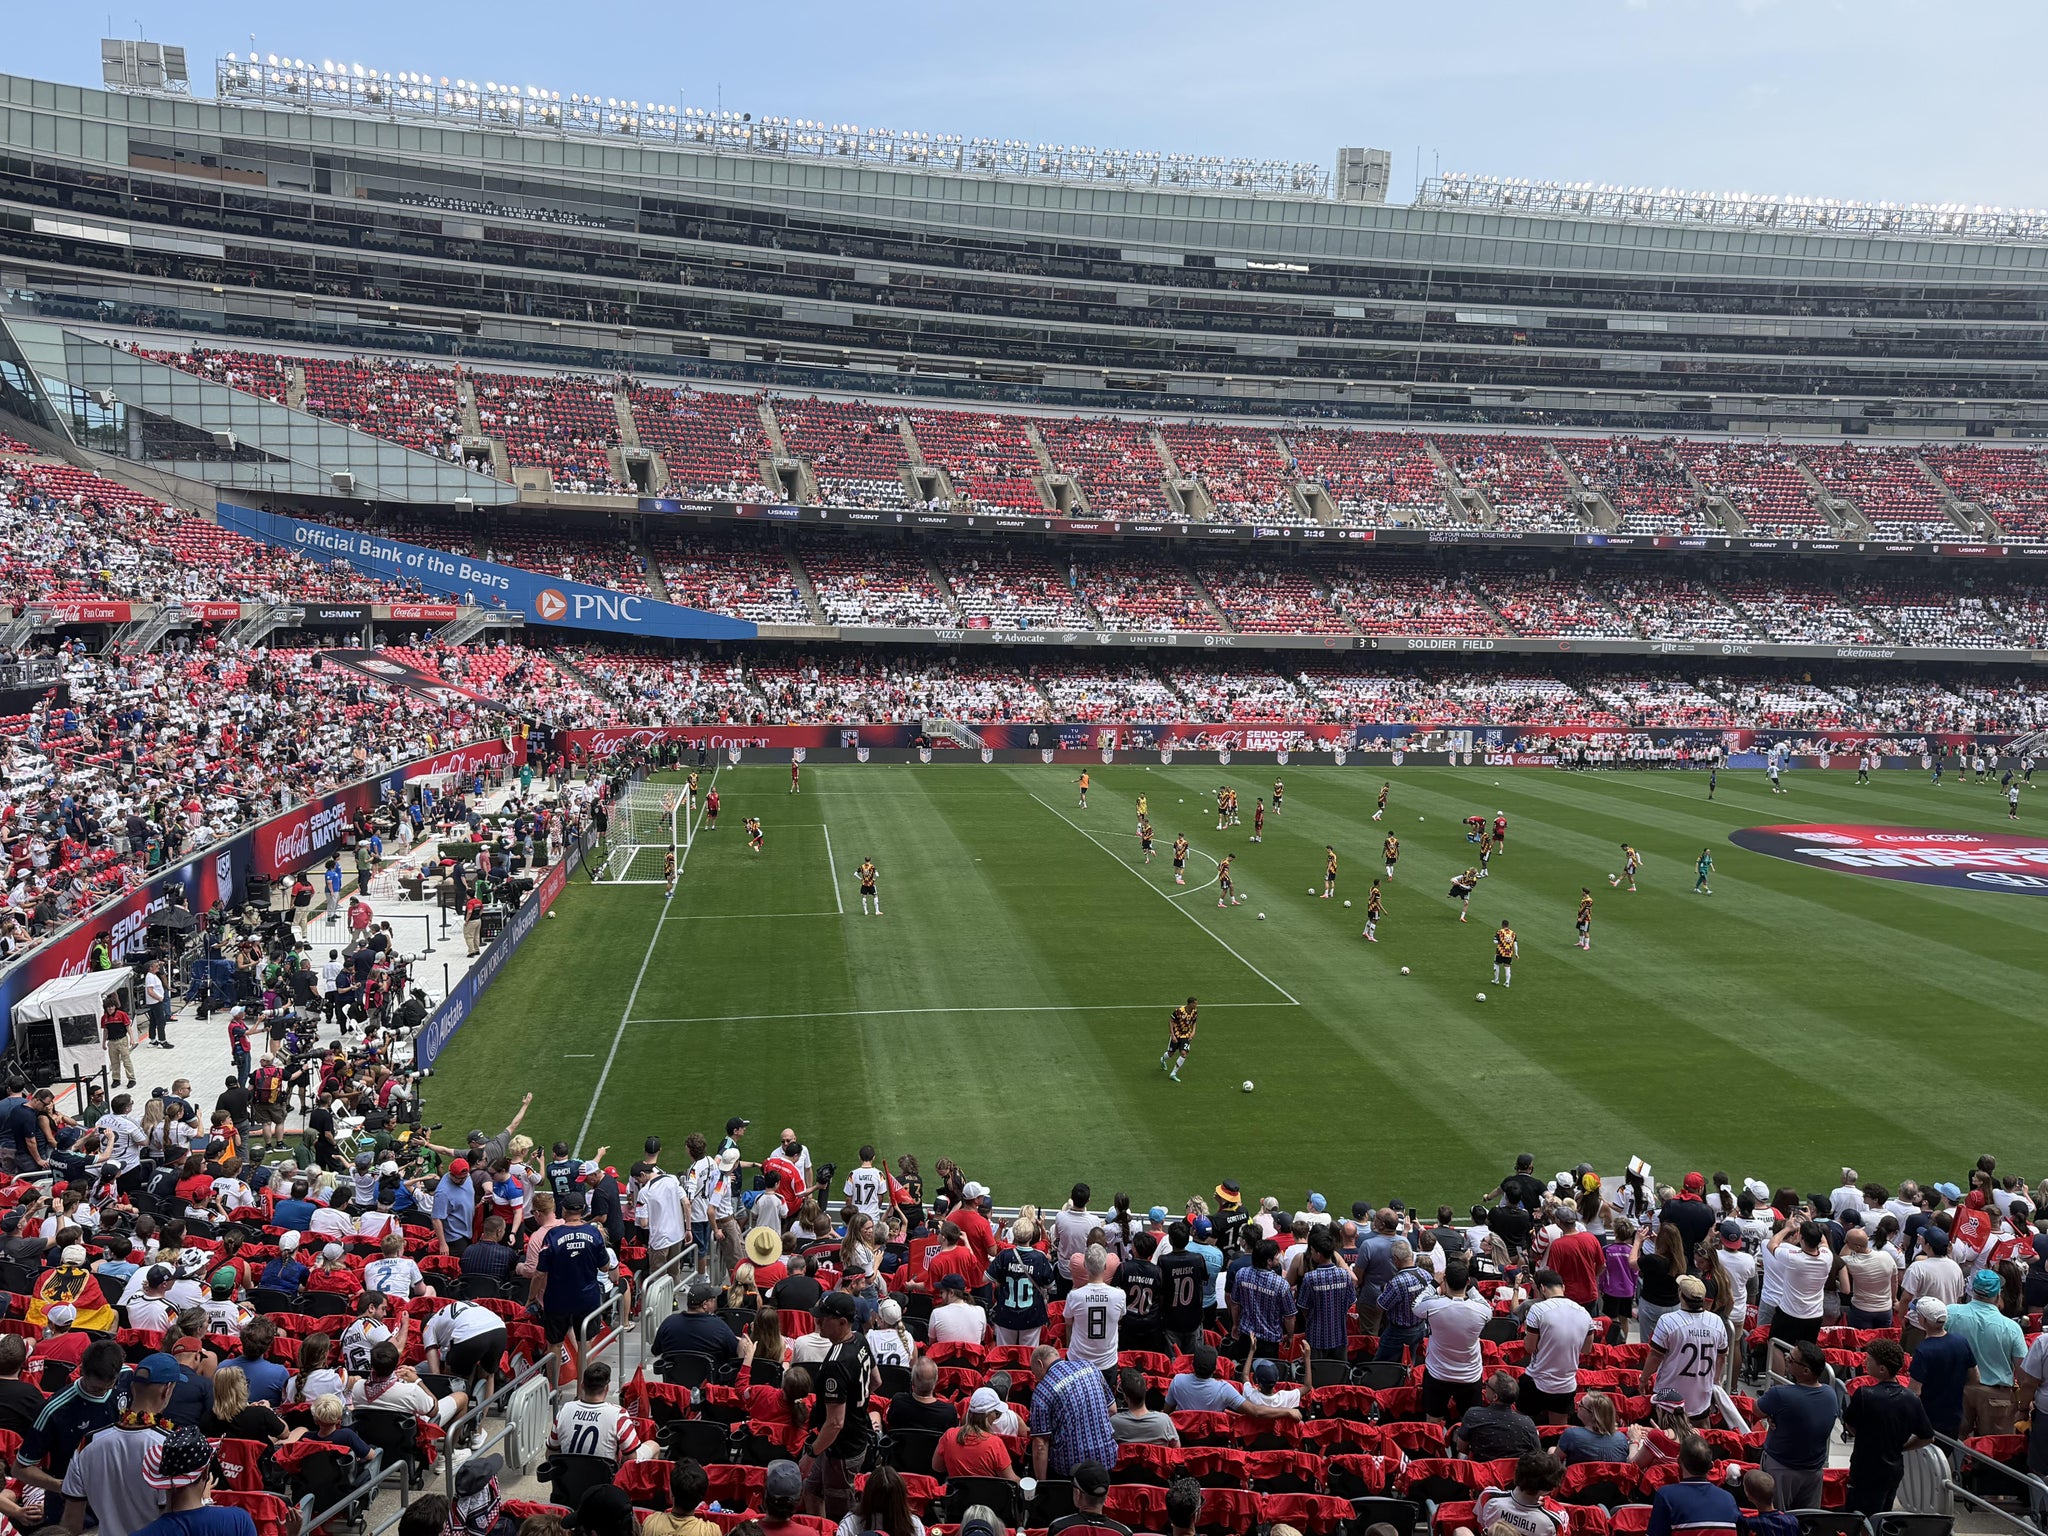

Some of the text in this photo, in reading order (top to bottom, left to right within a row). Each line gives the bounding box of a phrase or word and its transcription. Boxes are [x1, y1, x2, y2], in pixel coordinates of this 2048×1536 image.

[449, 199, 493, 209] SECURITY
[501, 206, 555, 217] ASSISTANCE
[557, 212, 579, 220] TEXT
[479, 208, 500, 216] THE
[504, 211, 537, 221] ISSUE
[553, 217, 607, 228] LOCATION
[462, 436, 472, 445] 302
[680, 504, 713, 512] USMNT
[767, 509, 799, 517] USMNT
[918, 516, 948, 524] USMNT
[1283, 529, 1291, 537] 0
[1303, 529, 1325, 538] 3:26
[1349, 531, 1365, 539] GER
[295, 526, 510, 590] Official Bank of the Bears
[83, 608, 95, 618] Fan
[95, 608, 116, 618] Corner
[207, 607, 218, 616] Fan
[218, 607, 238, 616] Corner
[393, 607, 422, 618] Coca-Cola
[571, 594, 642, 622] PNC
[320, 610, 362, 618] USMNT
[935, 630, 965, 639] VIZZY
[1004, 633, 1045, 643] Advocate
[1215, 637, 1236, 646] PNC
[1407, 639, 1494, 650] SOLDIER FIELD
[1661, 642, 1677, 653] Lite
[1732, 645, 1753, 654] PNC
[1836, 648, 1895, 659] ticketmaster
[1246, 730, 1305, 738] SEND-OFF
[710, 735, 770, 749] Cornr
[1246, 738, 1297, 749] MATC
[1484, 754, 1514, 765] USA
[1516, 755, 1541, 765] Coca-Cola
[310, 802, 347, 830] SEND-OFF
[1874, 834, 1985, 843] Coca-Cola
[274, 821, 310, 868] Coca-Cola
[218, 854, 231, 880] USA
[512, 900, 539, 945] Volkswagen
[111, 927, 147, 961] MAT
[477, 937, 509, 990] NEW YORK LIFE
[439, 999, 464, 1046] Allstate
[551, 1167, 571, 1177] KIMMICH
[149, 1174, 163, 1188] 8
[555, 1177, 570, 1193] 6
[854, 1183, 876, 1205] 17
[557, 1232, 594, 1246] UNITED STATES
[566, 1241, 586, 1250] SOCCER
[1171, 1266, 1195, 1277] PULISIC
[376, 1265, 393, 1292] 2
[1241, 1281, 1276, 1297] UNITED STATES
[1331, 1282, 1347, 1290] STATES
[1004, 1276, 1035, 1309] 10
[1171, 1276, 1195, 1308] 10
[1085, 1294, 1110, 1303] KROOS
[1126, 1284, 1154, 1316] 20
[1087, 1306, 1108, 1340] 8
[1688, 1328, 1711, 1338] MÜLLER
[880, 1342, 898, 1350] LLOYD
[1679, 1342, 1714, 1378] 25
[1053, 1367, 1095, 1391] UNITED STATES
[572, 1410, 602, 1424] PULISIC
[568, 1423, 600, 1455] 10
[1500, 1510, 1537, 1533] MUSIALA
